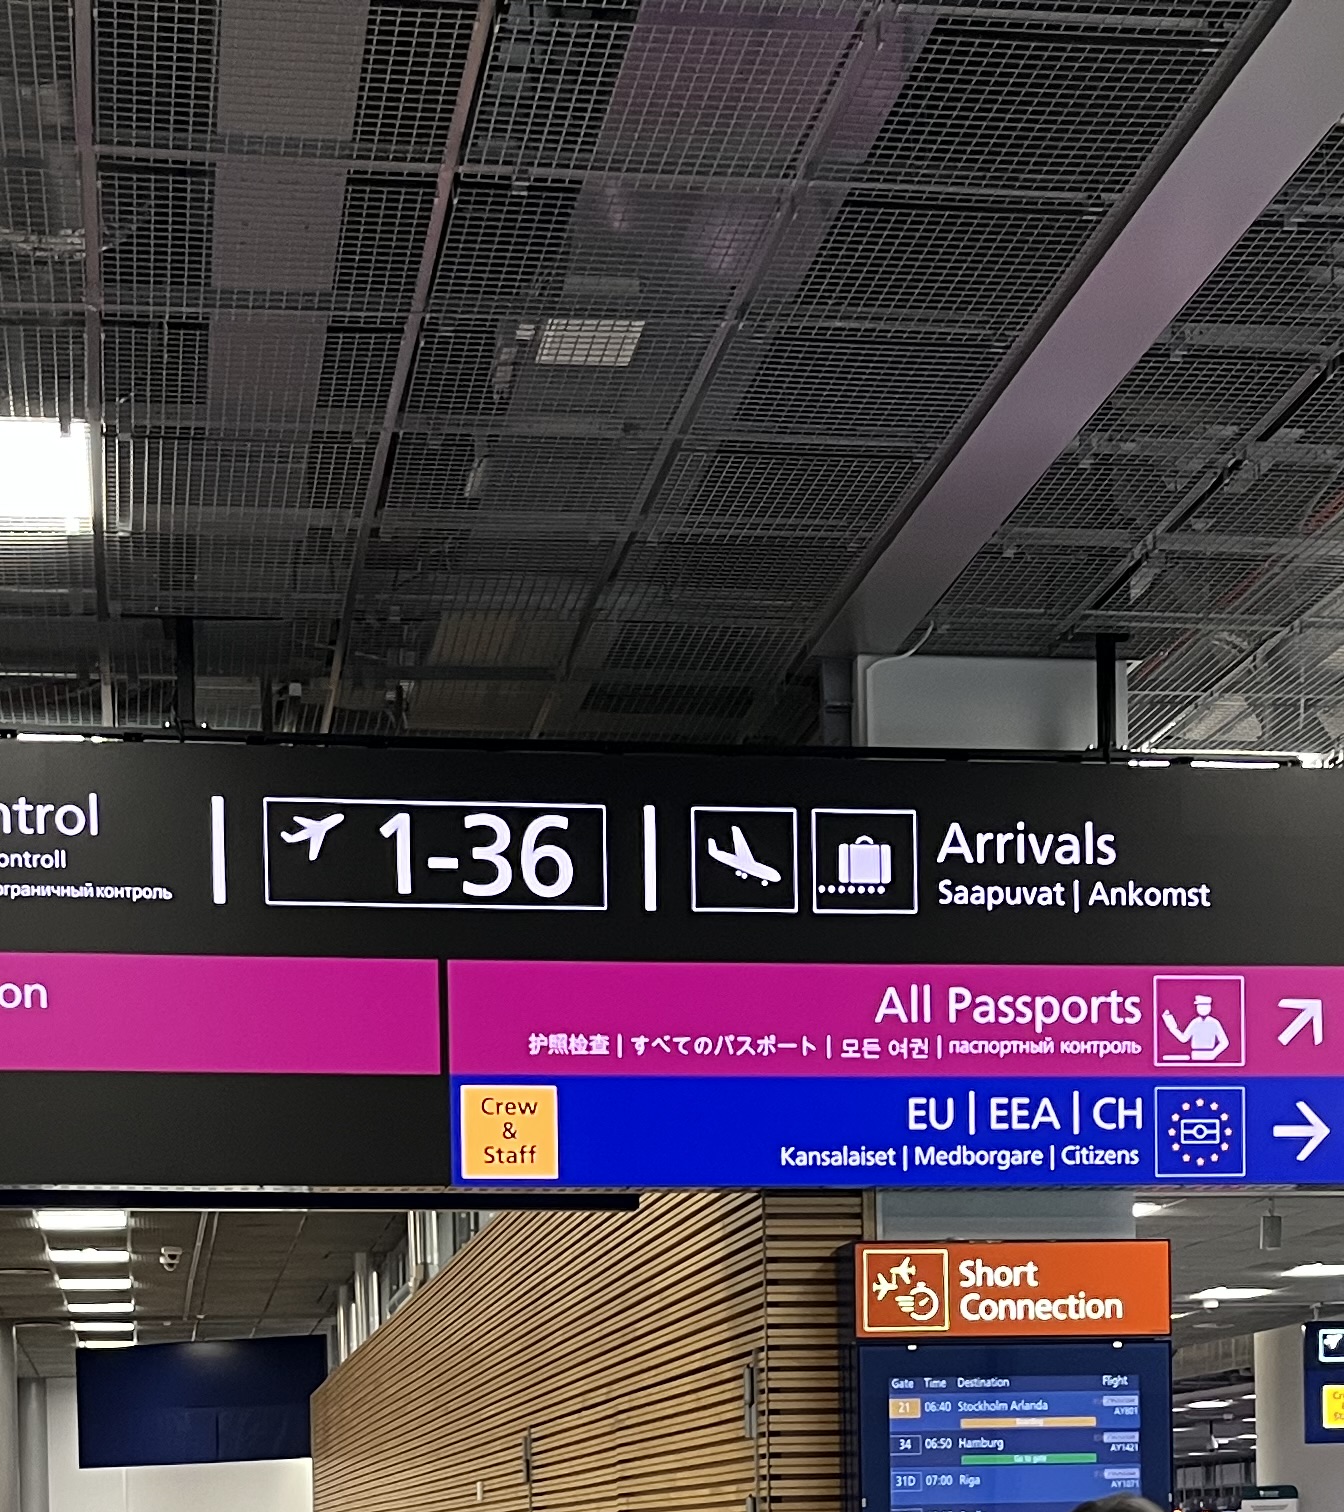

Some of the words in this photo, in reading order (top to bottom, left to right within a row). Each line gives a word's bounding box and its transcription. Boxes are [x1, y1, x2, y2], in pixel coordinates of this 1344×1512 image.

[937, 821, 1117, 866] Arrivals
[379, 812, 574, 898] 1-36
[938, 879, 1066, 912] Saapuvat
[1088, 880, 1212, 907] Ankomst
[874, 984, 931, 1024] All
[948, 987, 1142, 1033] Passports
[529, 1033, 610, 1056] 护照检查
[631, 1034, 817, 1056] すべてのパスポート
[840, 1038, 881, 1059] 모든
[888, 1037, 929, 1059] 여권
[949, 1036, 1055, 1057] паспортный
[1060, 1040, 1142, 1057] контроль
[481, 1097, 538, 1115] Crew
[908, 1097, 955, 1131] EU
[990, 1097, 1061, 1131] EEA
[1093, 1097, 1143, 1131] CH
[503, 1122, 517, 1139] &
[484, 1145, 537, 1164] Staff
[781, 1146, 896, 1167] Kansalaiset
[915, 1145, 1044, 1171] Medborgare
[1061, 1145, 1140, 1166] Citizens
[959, 1258, 1039, 1288] Short
[959, 1290, 1124, 1321] Connection
[891, 1378, 914, 1389] Gate
[924, 1377, 947, 1388] Time
[957, 1377, 1010, 1388] Destination
[899, 1402, 910, 1413] 21
[924, 1401, 952, 1412] 06:40
[957, 1400, 1008, 1412] Stockholm
[1010, 1399, 1049, 1411] Arlanda
[899, 1439, 912, 1450] 34
[924, 1438, 952, 1449] 06:50
[958, 1437, 1004, 1451] Hamburg
[896, 1475, 916, 1486] 31D
[925, 1475, 953, 1485] 07:00
[959, 1474, 981, 1488] Riga
